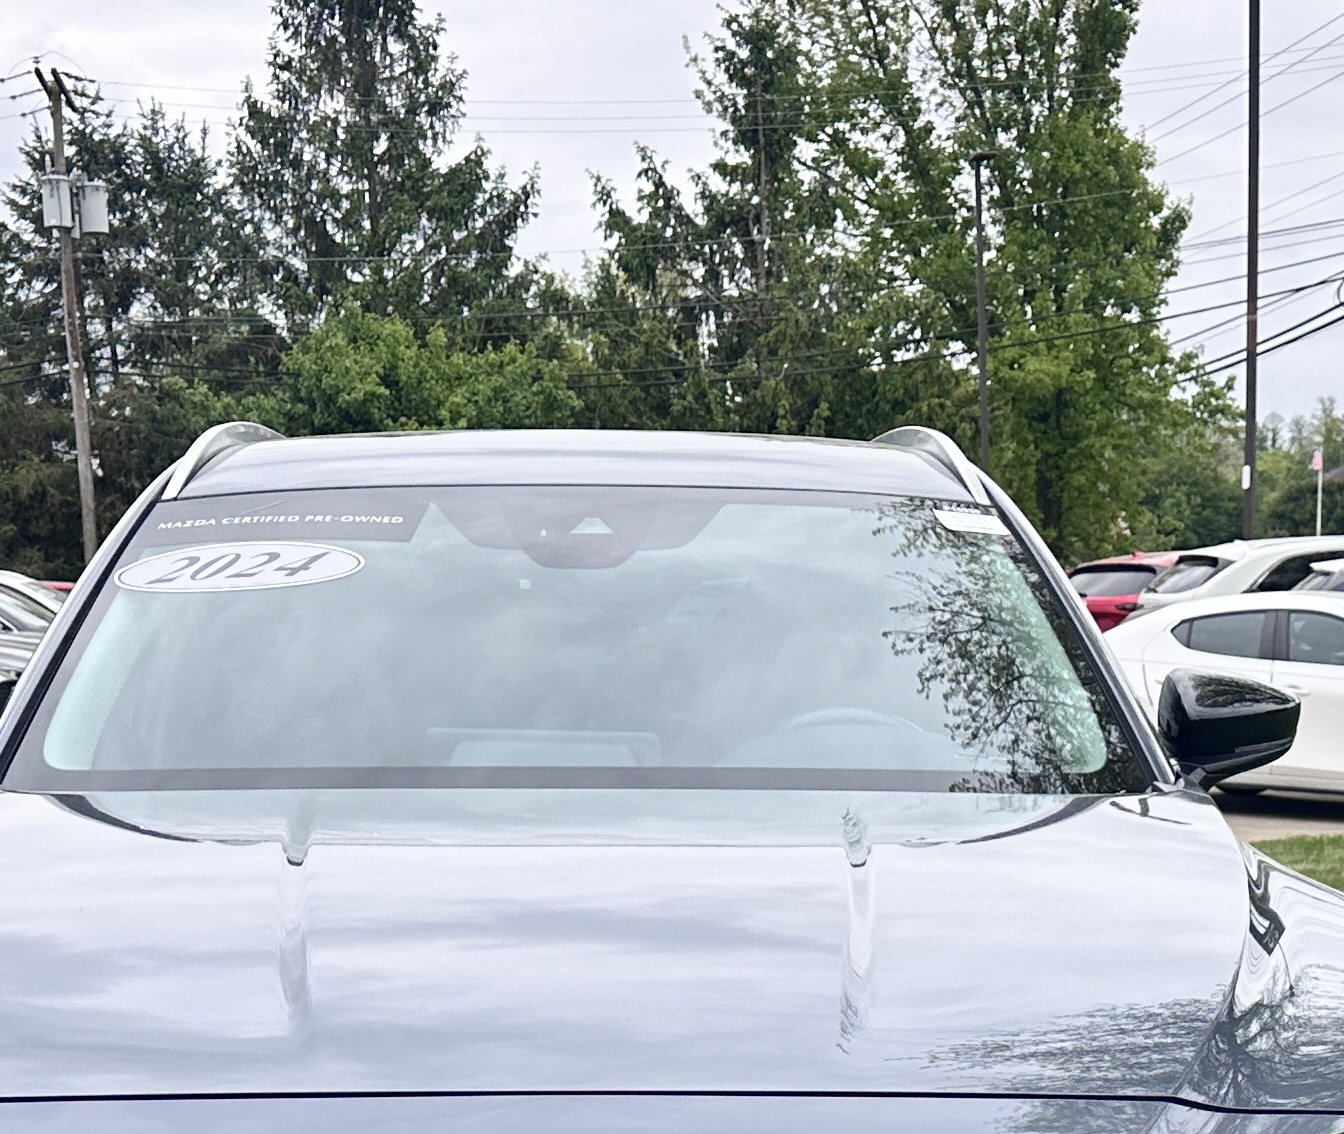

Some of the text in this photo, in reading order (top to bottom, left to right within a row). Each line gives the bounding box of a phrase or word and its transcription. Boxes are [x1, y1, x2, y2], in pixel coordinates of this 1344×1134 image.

[157, 513, 405, 530] MAZDA CERTIFIED PRE-OWNED
[144, 551, 332, 586] 2024
